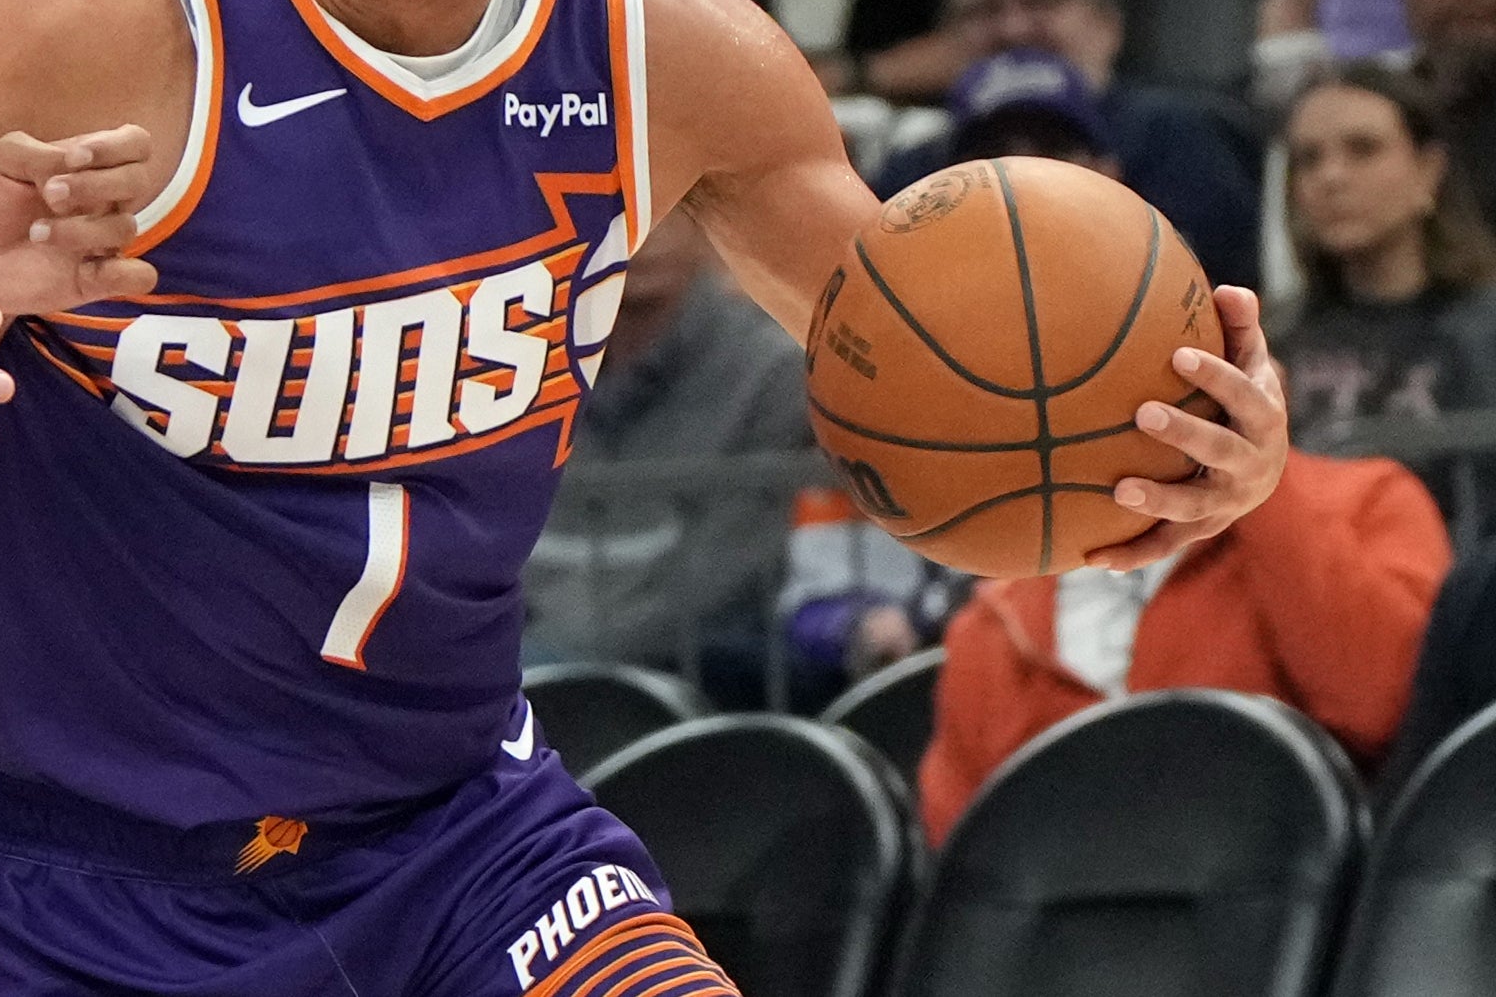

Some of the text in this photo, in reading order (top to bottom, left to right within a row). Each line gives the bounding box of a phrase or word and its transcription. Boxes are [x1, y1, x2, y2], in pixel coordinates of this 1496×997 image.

[505, 92, 608, 137] PayPal
[111, 260, 554, 464] SUNS
[320, 482, 411, 671] 1
[507, 864, 661, 991] PHOEN
